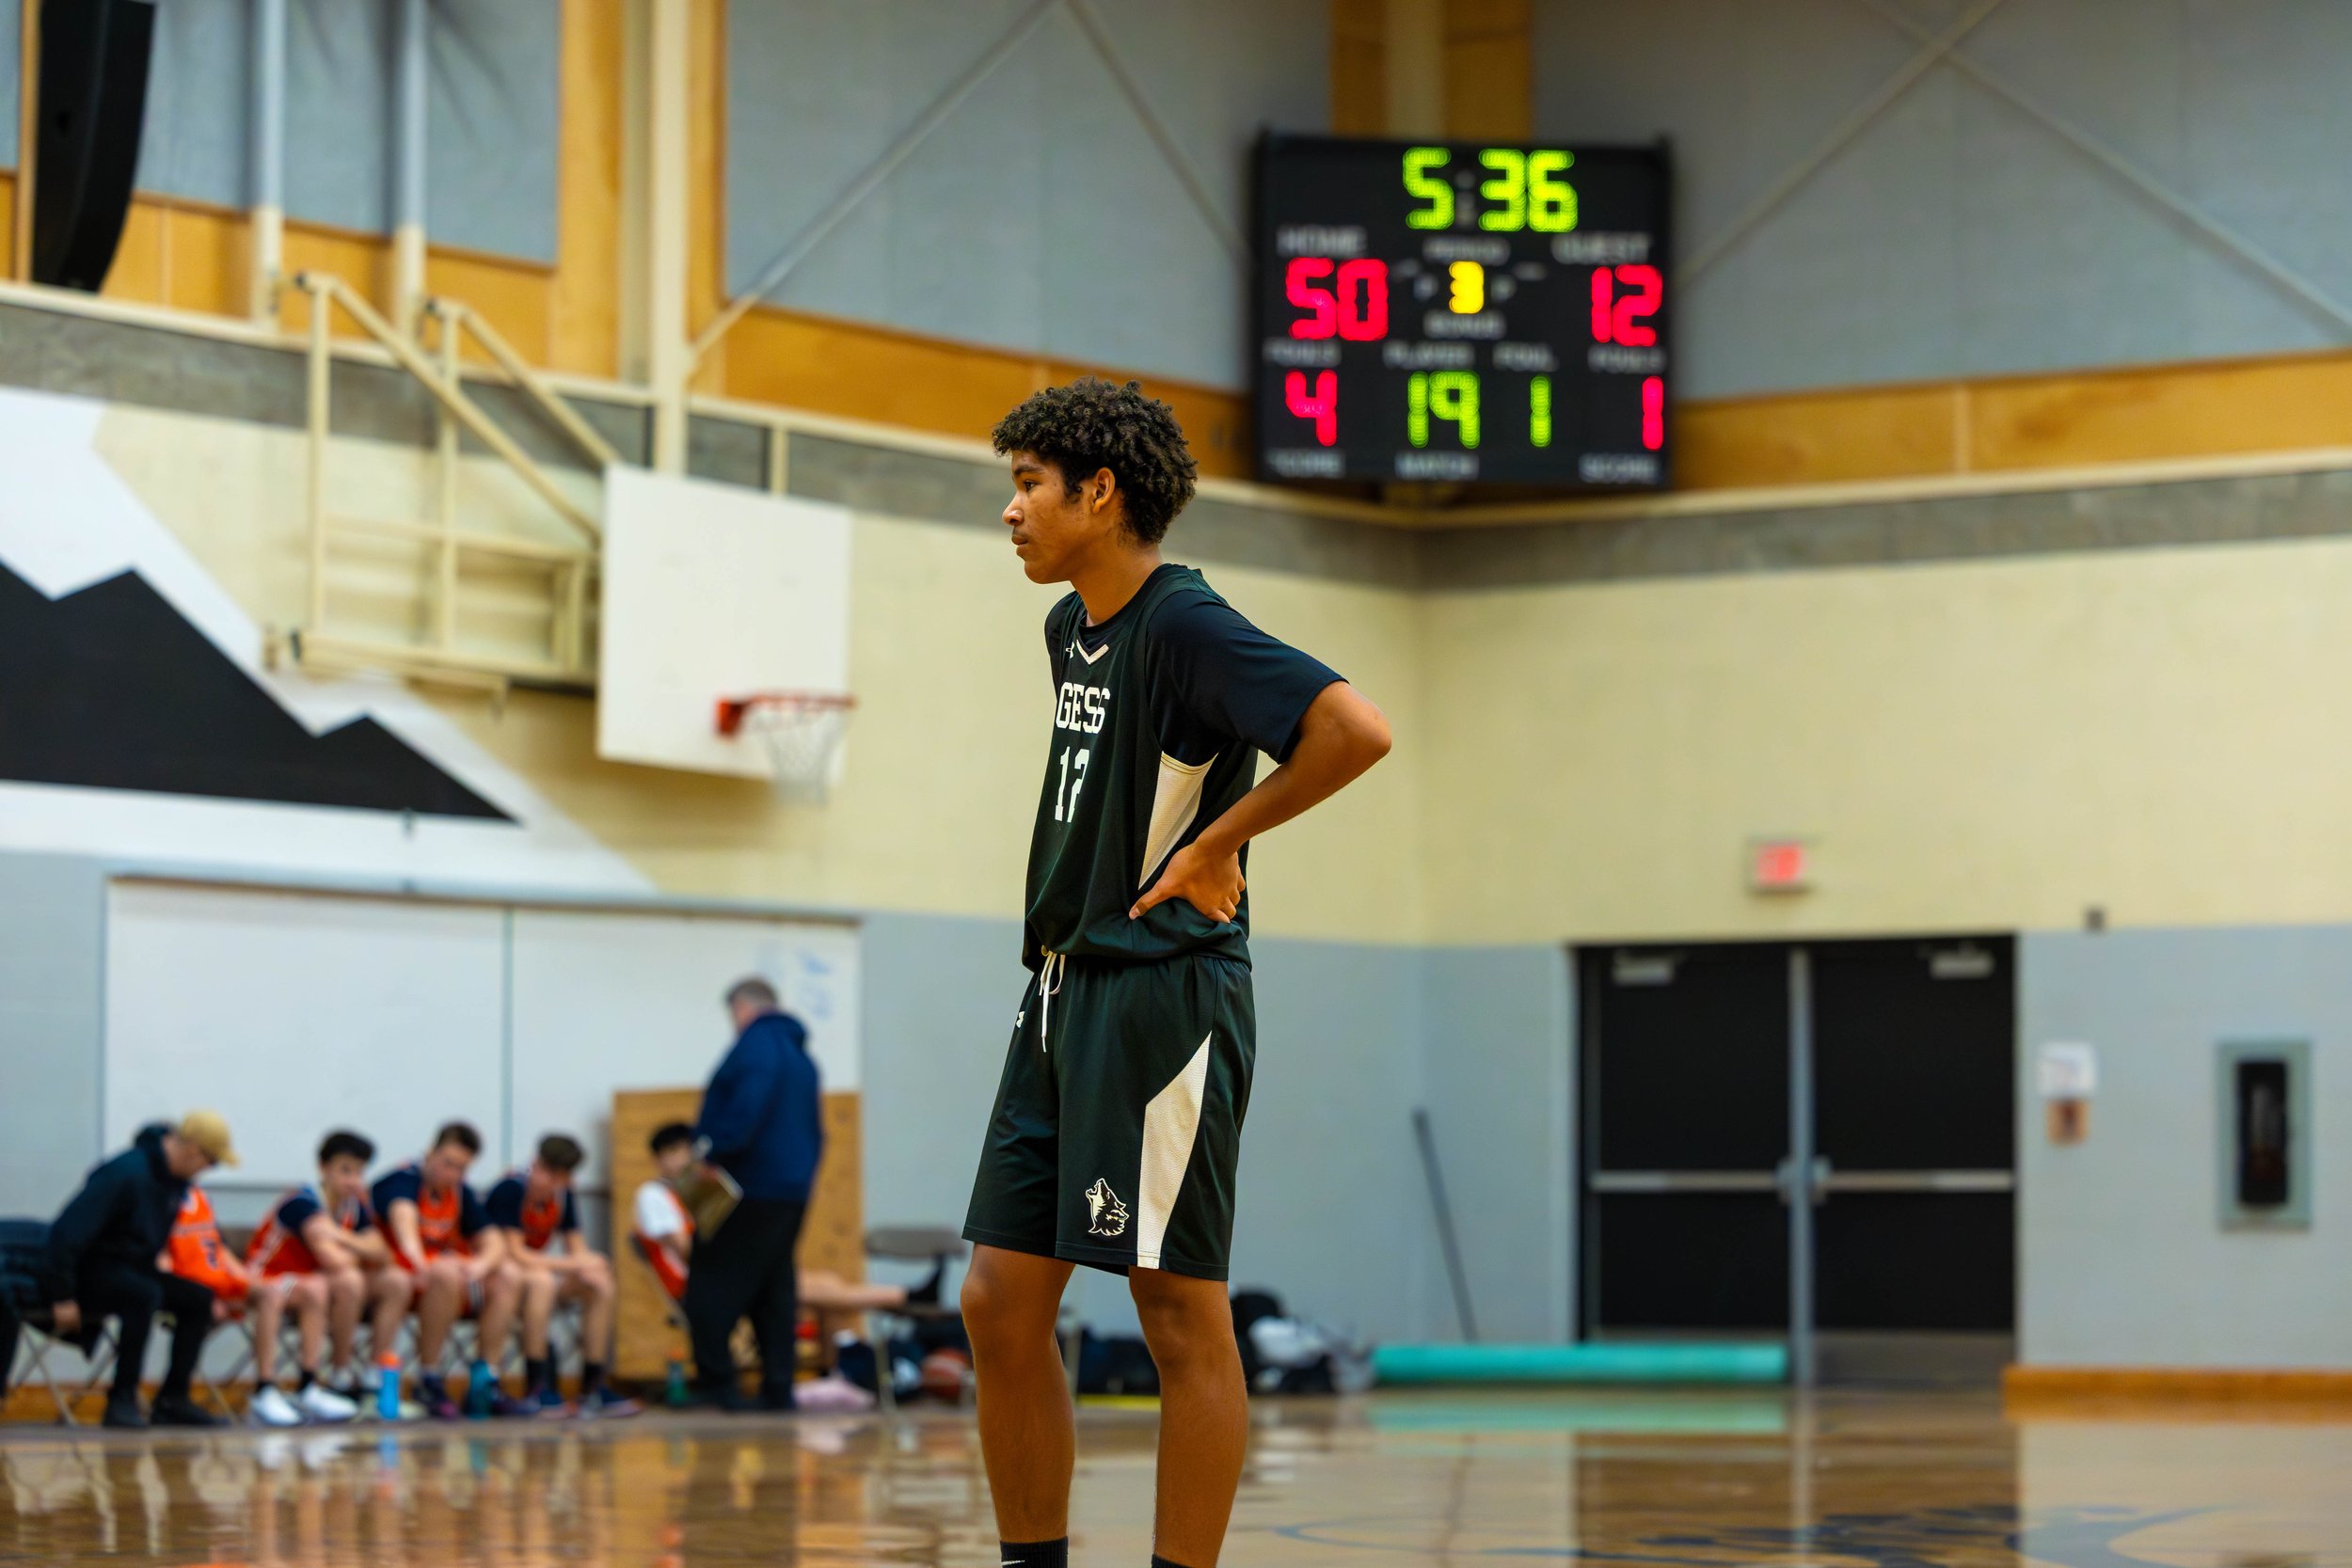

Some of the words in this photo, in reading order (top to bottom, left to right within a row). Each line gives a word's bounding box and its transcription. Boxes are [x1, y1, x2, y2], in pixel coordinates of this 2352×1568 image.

[1286, 258, 1389, 341] 50
[1449, 261, 1485, 314] 3
[1591, 264, 1662, 347] 12
[1285, 370, 1338, 447] 4
[1407, 371, 1481, 450] 19
[1530, 374, 1551, 448] 1
[1642, 375, 1663, 451] 1
[1055, 746, 1090, 823] 12
